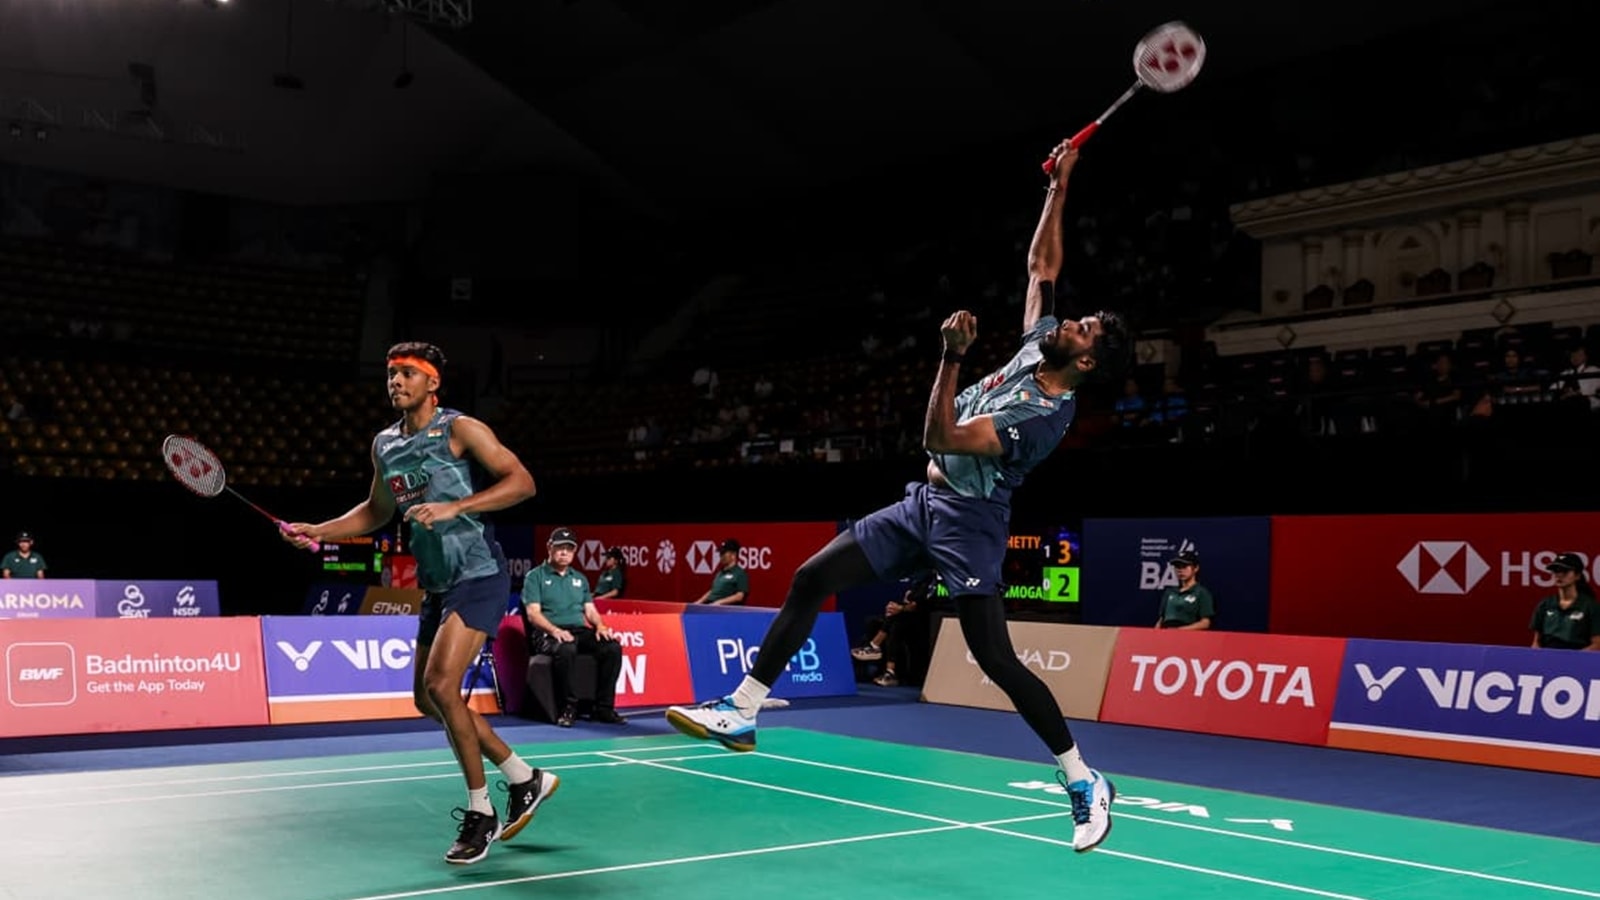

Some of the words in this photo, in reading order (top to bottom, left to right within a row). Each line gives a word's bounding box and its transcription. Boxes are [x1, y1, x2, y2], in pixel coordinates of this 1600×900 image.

[1008, 536, 1041, 549] HETTY
[1058, 540, 1071, 564] 3
[610, 547, 648, 567] SBC
[738, 547, 771, 570] SBC
[1058, 574, 1070, 597] 2
[1140, 561, 1180, 590] BA
[19, 667, 65, 681] BWF
[86, 653, 240, 675] Badminton4U
[86, 681, 110, 693] Get
[113, 681, 134, 692] the
[137, 680, 165, 694] App
[167, 679, 205, 692] Today
[792, 671, 823, 682] media
[1131, 655, 1315, 707] TOYOTA
